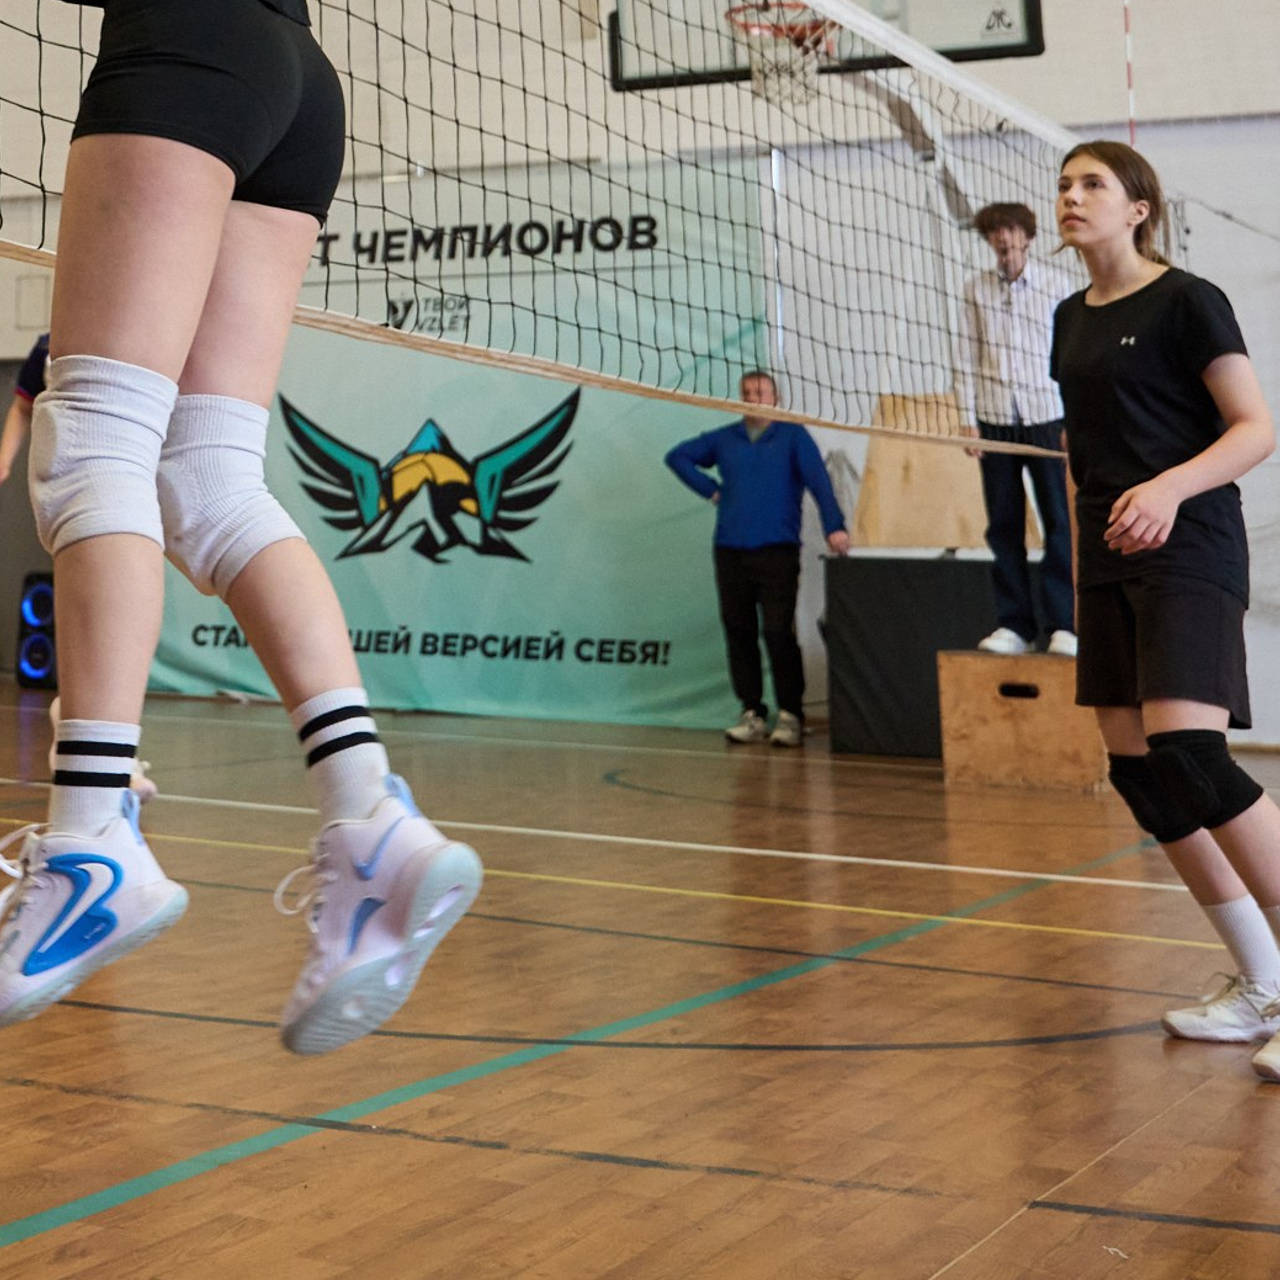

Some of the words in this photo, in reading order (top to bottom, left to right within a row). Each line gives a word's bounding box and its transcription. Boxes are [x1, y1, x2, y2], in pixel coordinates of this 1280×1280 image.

[352, 214, 659, 264] ЧЕМПИОНОВ
[191, 624, 249, 649] СТА
[348, 627, 412, 655] ШЕЙ
[419, 630, 566, 662] ВЕРСИЕЙ
[574, 637, 672, 666] СЕБЯ!
